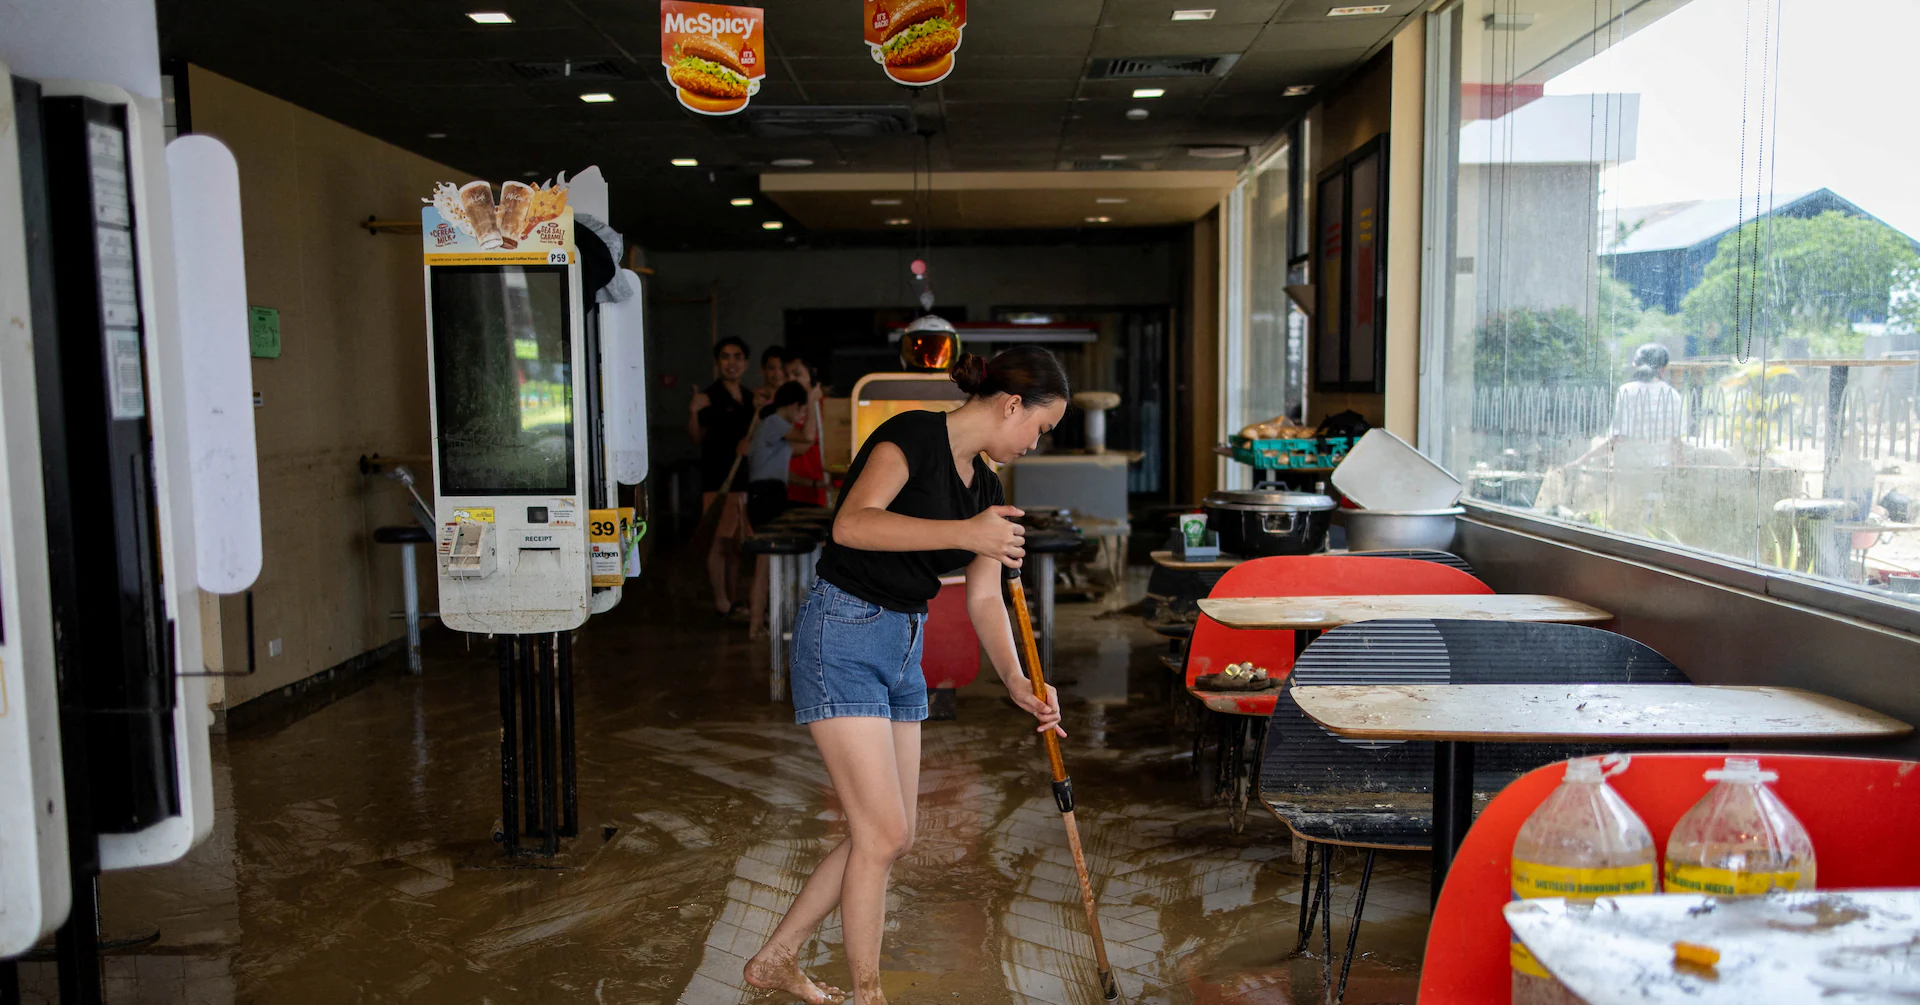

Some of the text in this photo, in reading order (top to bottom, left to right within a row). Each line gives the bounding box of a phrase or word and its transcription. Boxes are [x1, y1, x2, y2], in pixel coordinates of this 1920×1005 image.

[876, 12, 887, 21] IT'S
[664, 12, 756, 39] McSpicy
[874, 19, 889, 29] BACK!
[742, 50, 753, 58] IT'S
[432, 227, 455, 238] CEREAL
[541, 225, 551, 233] SEA
[552, 227, 565, 235] SALT
[437, 235, 452, 244] MILK
[591, 521, 615, 536] 39
